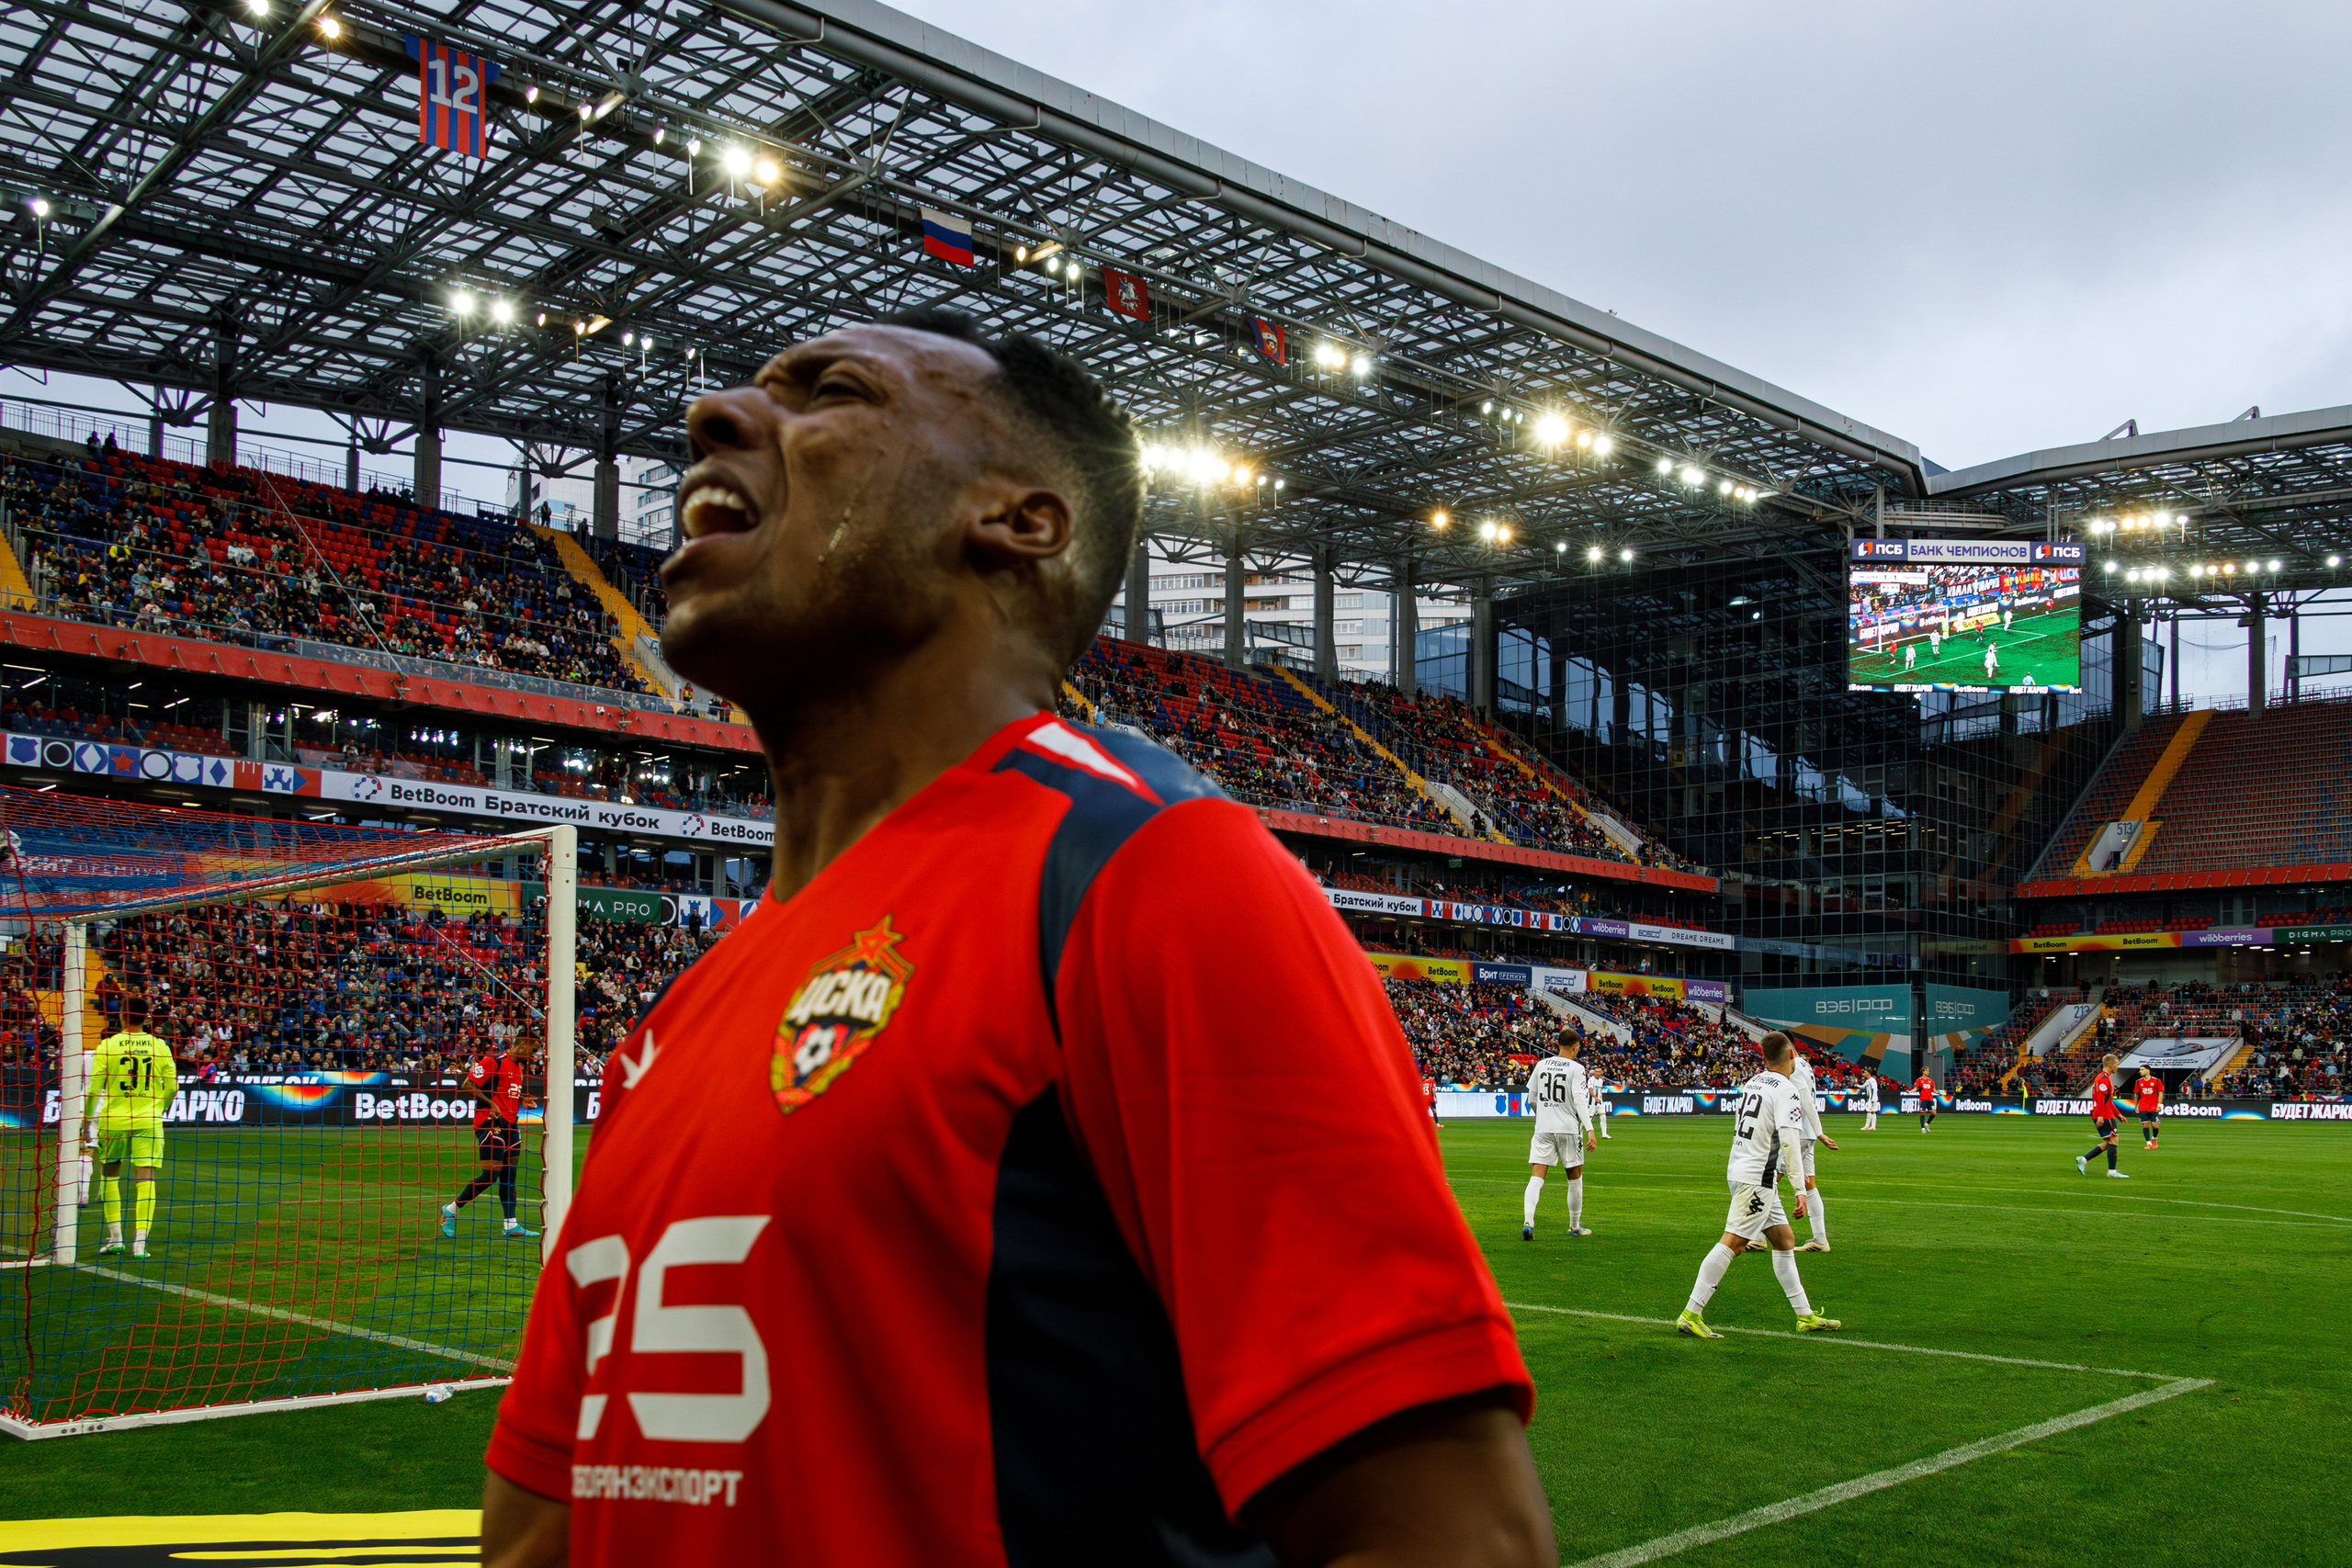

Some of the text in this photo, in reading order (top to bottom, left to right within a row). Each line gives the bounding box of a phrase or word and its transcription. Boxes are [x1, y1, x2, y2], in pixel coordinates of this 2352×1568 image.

[428, 58, 479, 115] 12
[1875, 544, 1903, 555] ПСБ
[1910, 546, 2027, 558] БАНК ЧЕМПИОНОВ
[2053, 547, 2080, 558] ПСБ
[390, 784, 660, 829] BetBoom Братский кубок
[2117, 823, 2132, 835] 513
[413, 885, 488, 904] BetBoom
[613, 901, 650, 917] PRO
[1333, 894, 1418, 913] Братский кубок
[1592, 922, 1626, 935] wildberries
[1671, 931, 1724, 945] DREAME DREAME
[2122, 937, 2158, 945] BetBoom
[2199, 932, 2253, 943] wildberries
[2033, 941, 2067, 949] BetBoom
[1428, 965, 1458, 977] BetBoom
[1479, 967, 1527, 982] Брит ПРЕМИУМ
[1599, 979, 1623, 989] BetBoom
[1652, 984, 1675, 993] BetBoom
[786, 970, 891, 1025] ЦСКА
[1688, 986, 1724, 999] wildberries
[119, 1056, 153, 1091] 31
[1539, 1072, 1567, 1103] 36
[1643, 1097, 1693, 1114] БУДЕТ ЖАРКО
[1956, 1100, 1992, 1111] BetBoom
[2035, 1100, 2069, 1115] БУДЕТ
[2271, 1104, 2310, 1120] БУДЕТ
